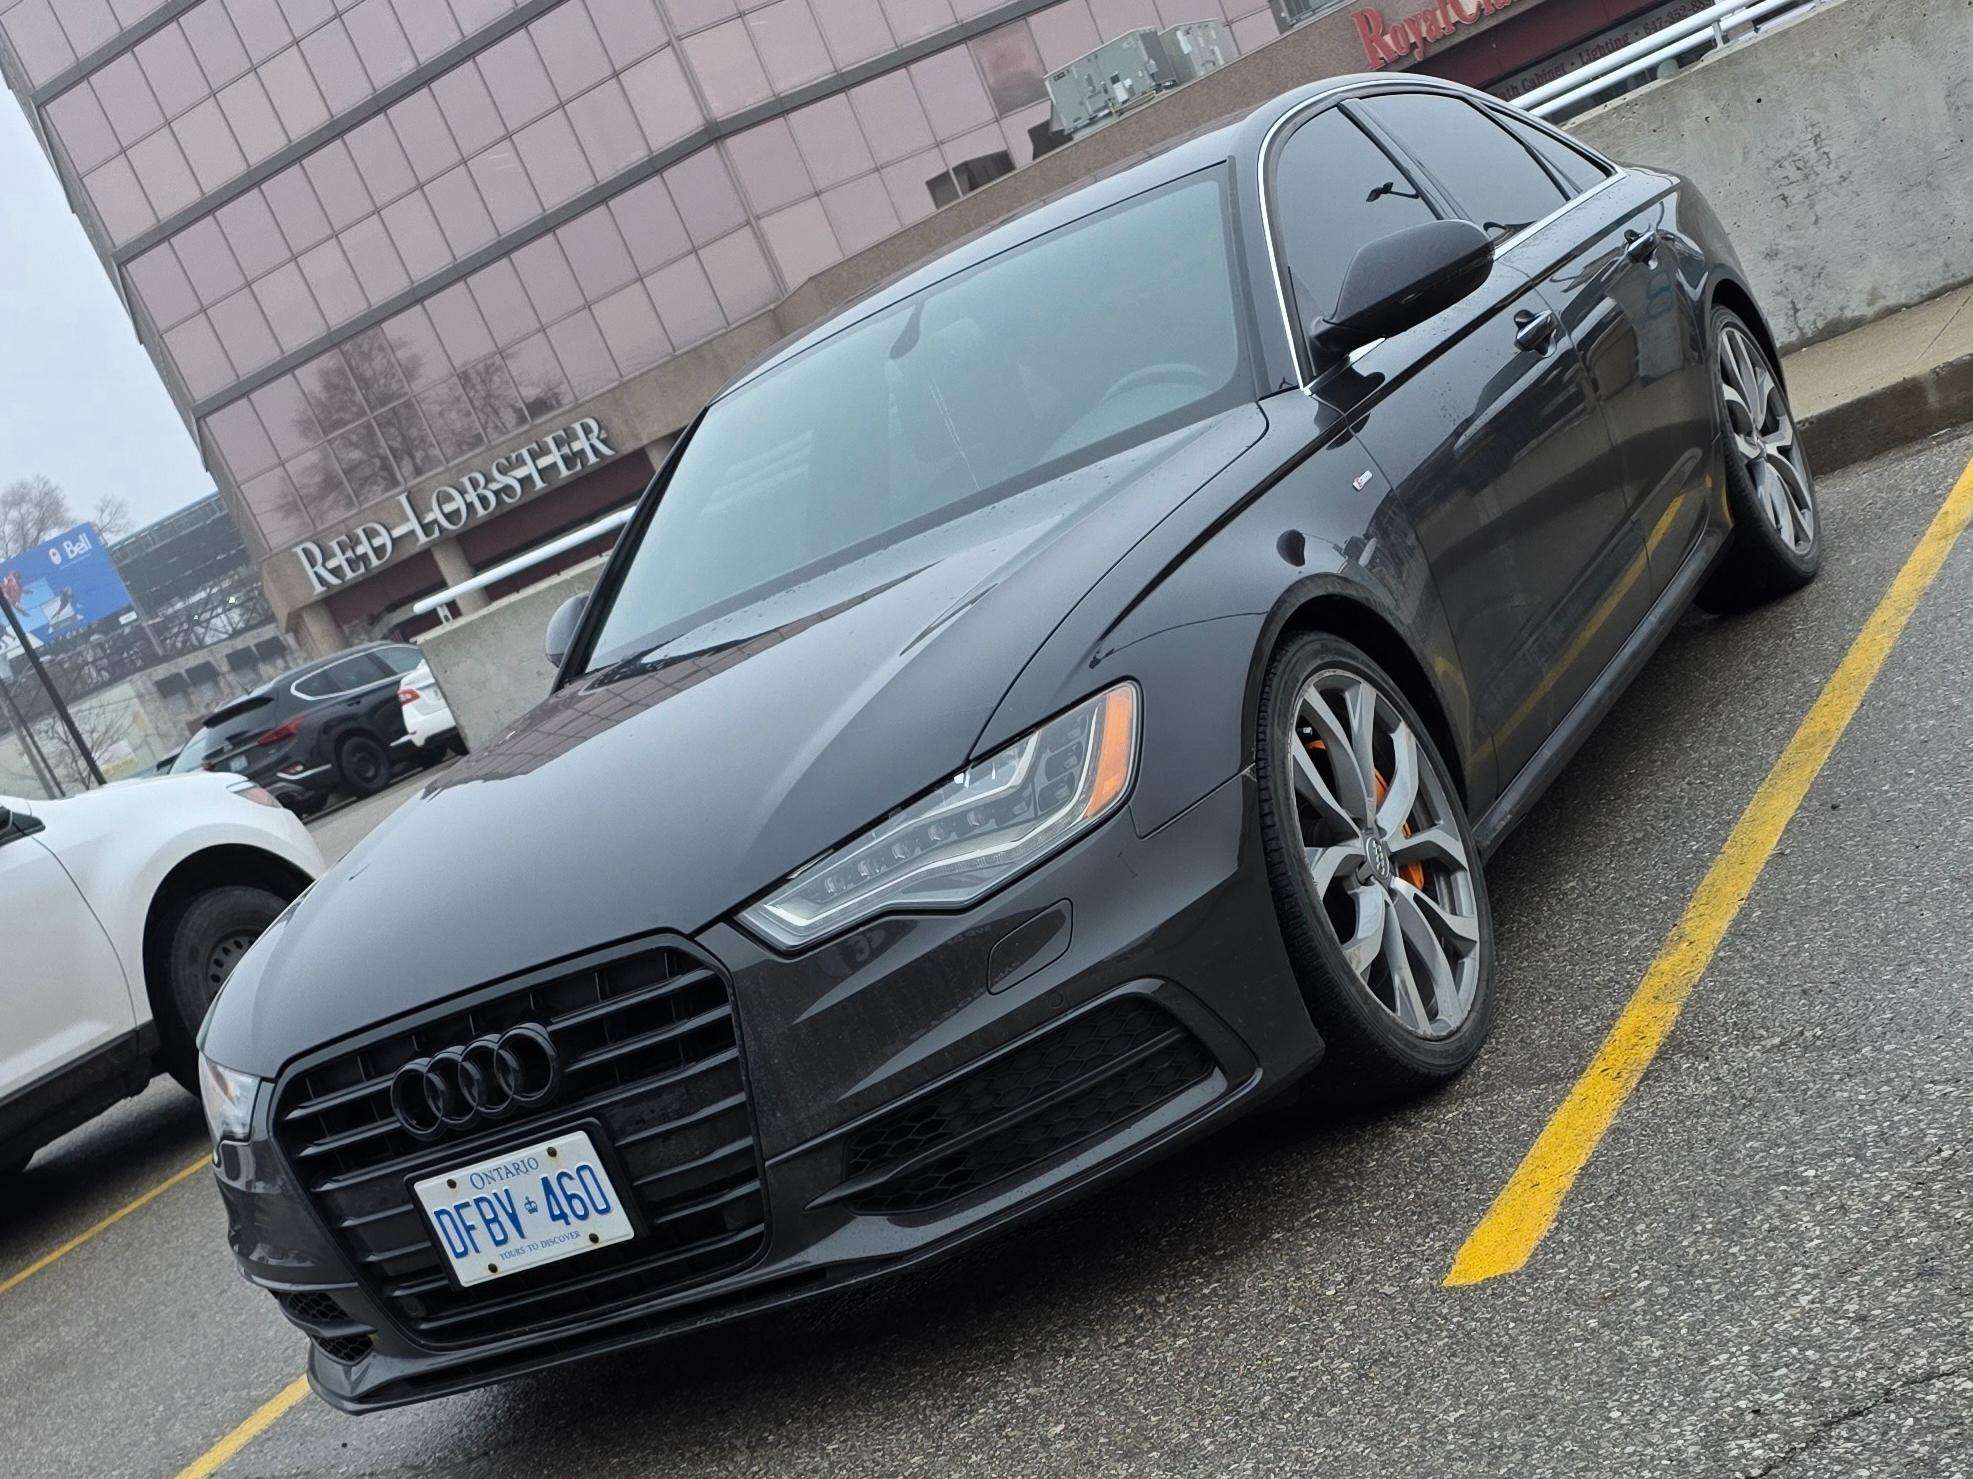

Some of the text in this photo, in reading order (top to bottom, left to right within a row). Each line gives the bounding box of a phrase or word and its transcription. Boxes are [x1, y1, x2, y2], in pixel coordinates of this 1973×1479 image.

[1521, 62, 1568, 90] Cabinet
[1578, 31, 1632, 66] Lighting
[292, 416, 616, 595] RED LOBSTER
[62, 532, 93, 560] Bell
[469, 1156, 540, 1191] ONTARIO
[433, 1163, 612, 1260] DFBV 460
[527, 1242, 540, 1253] TO
[541, 1229, 582, 1249] DISCOVER
